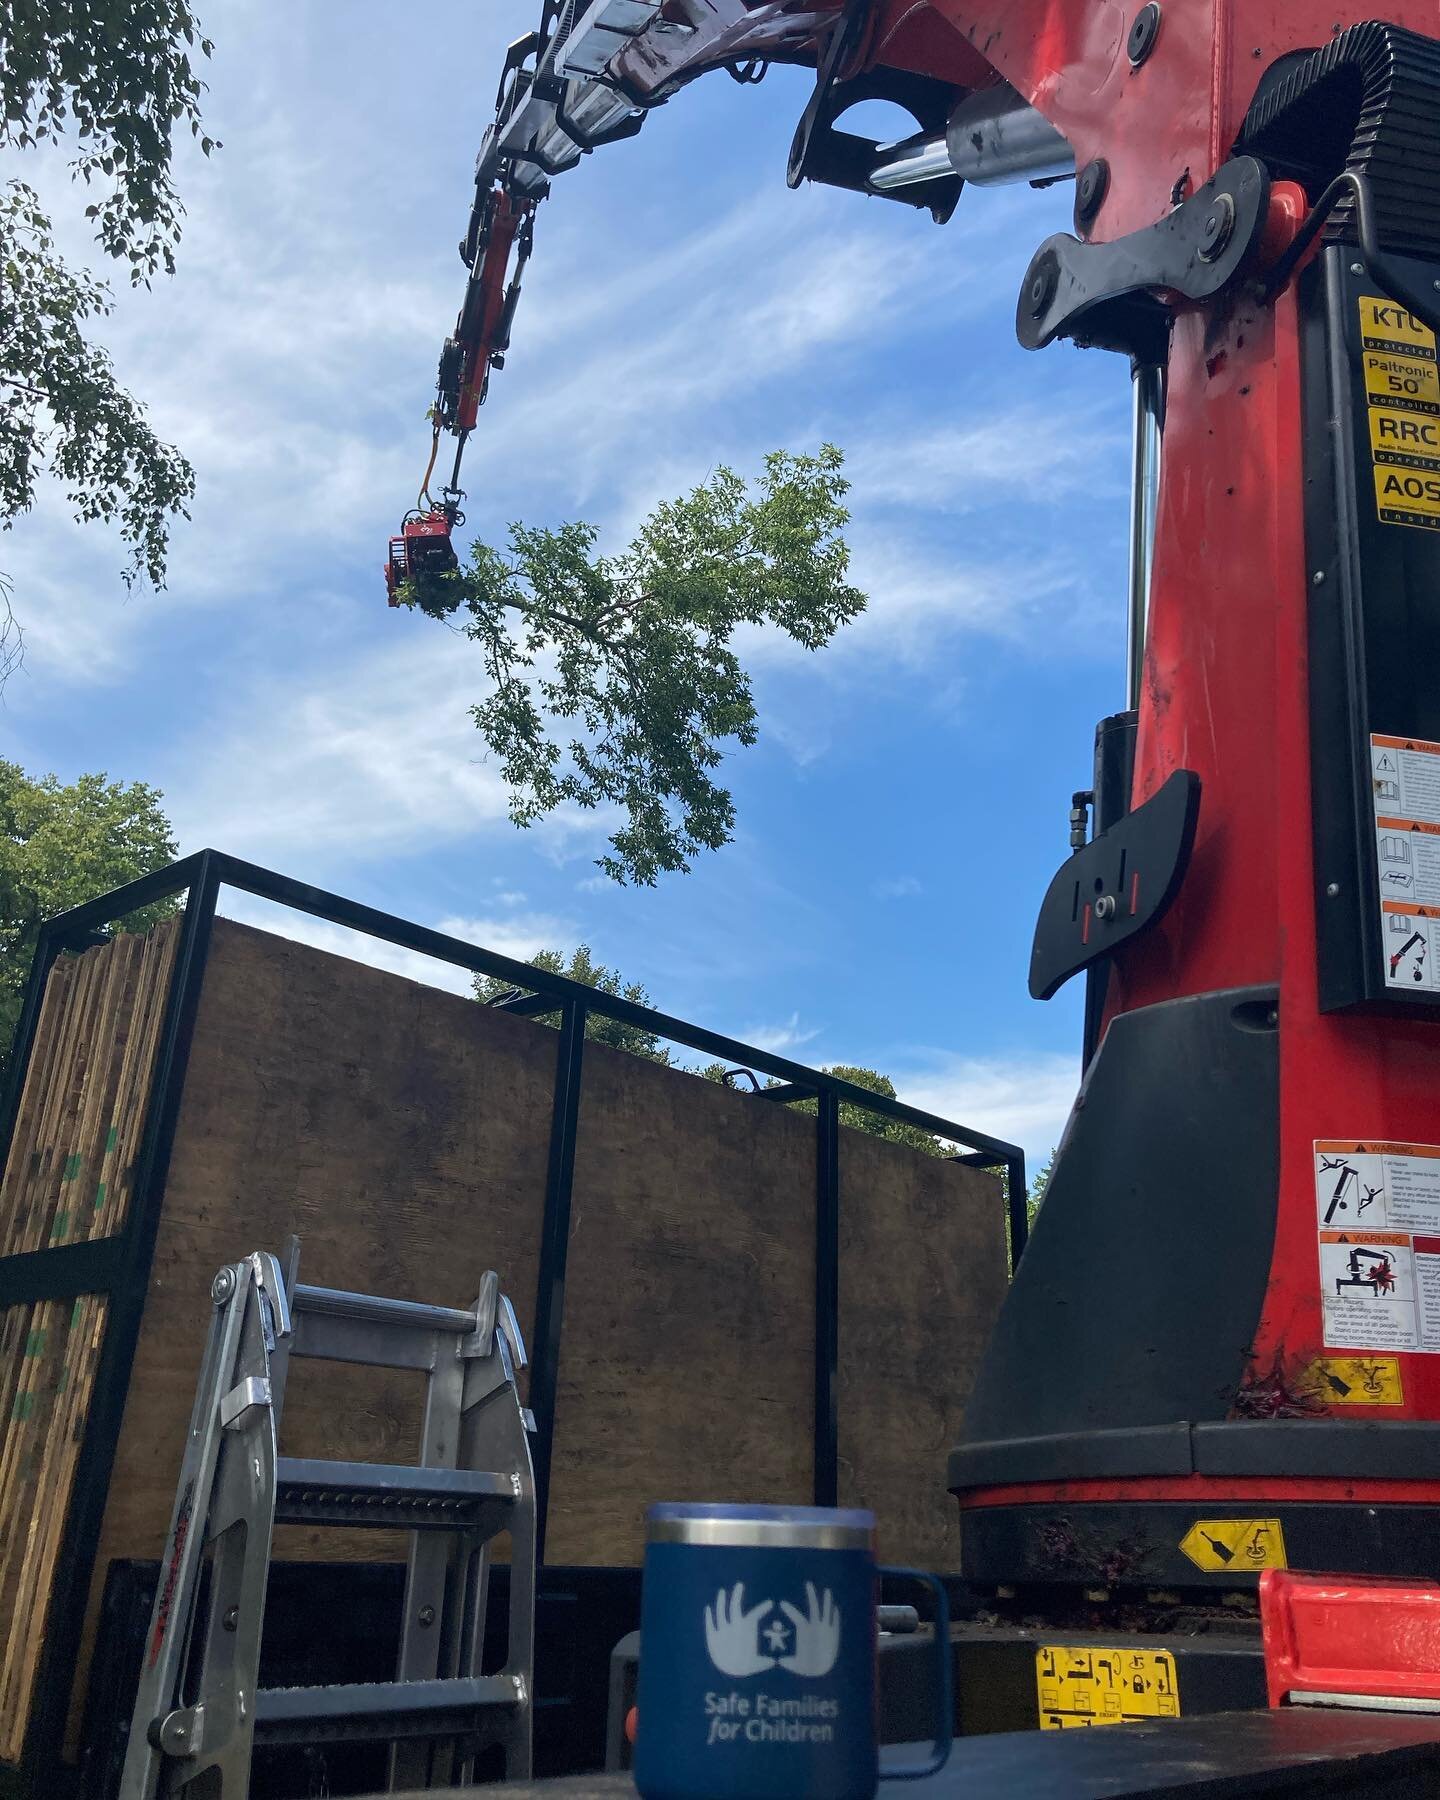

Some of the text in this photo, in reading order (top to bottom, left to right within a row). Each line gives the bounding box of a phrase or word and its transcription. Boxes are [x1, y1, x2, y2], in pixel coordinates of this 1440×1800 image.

[1368, 341, 1431, 357] protected
[1368, 358, 1434, 379] Paltronic
[1388, 376, 1419, 395] 50
[1373, 397, 1437, 412] controlled
[1379, 417, 1438, 446] RRC
[1383, 474, 1440, 502] AOS
[1371, 1144, 1414, 1155] WARNING
[1353, 1234, 1402, 1245] WARNING
[704, 1692, 840, 1718] Safe Families
[706, 1716, 834, 1746] for Children
